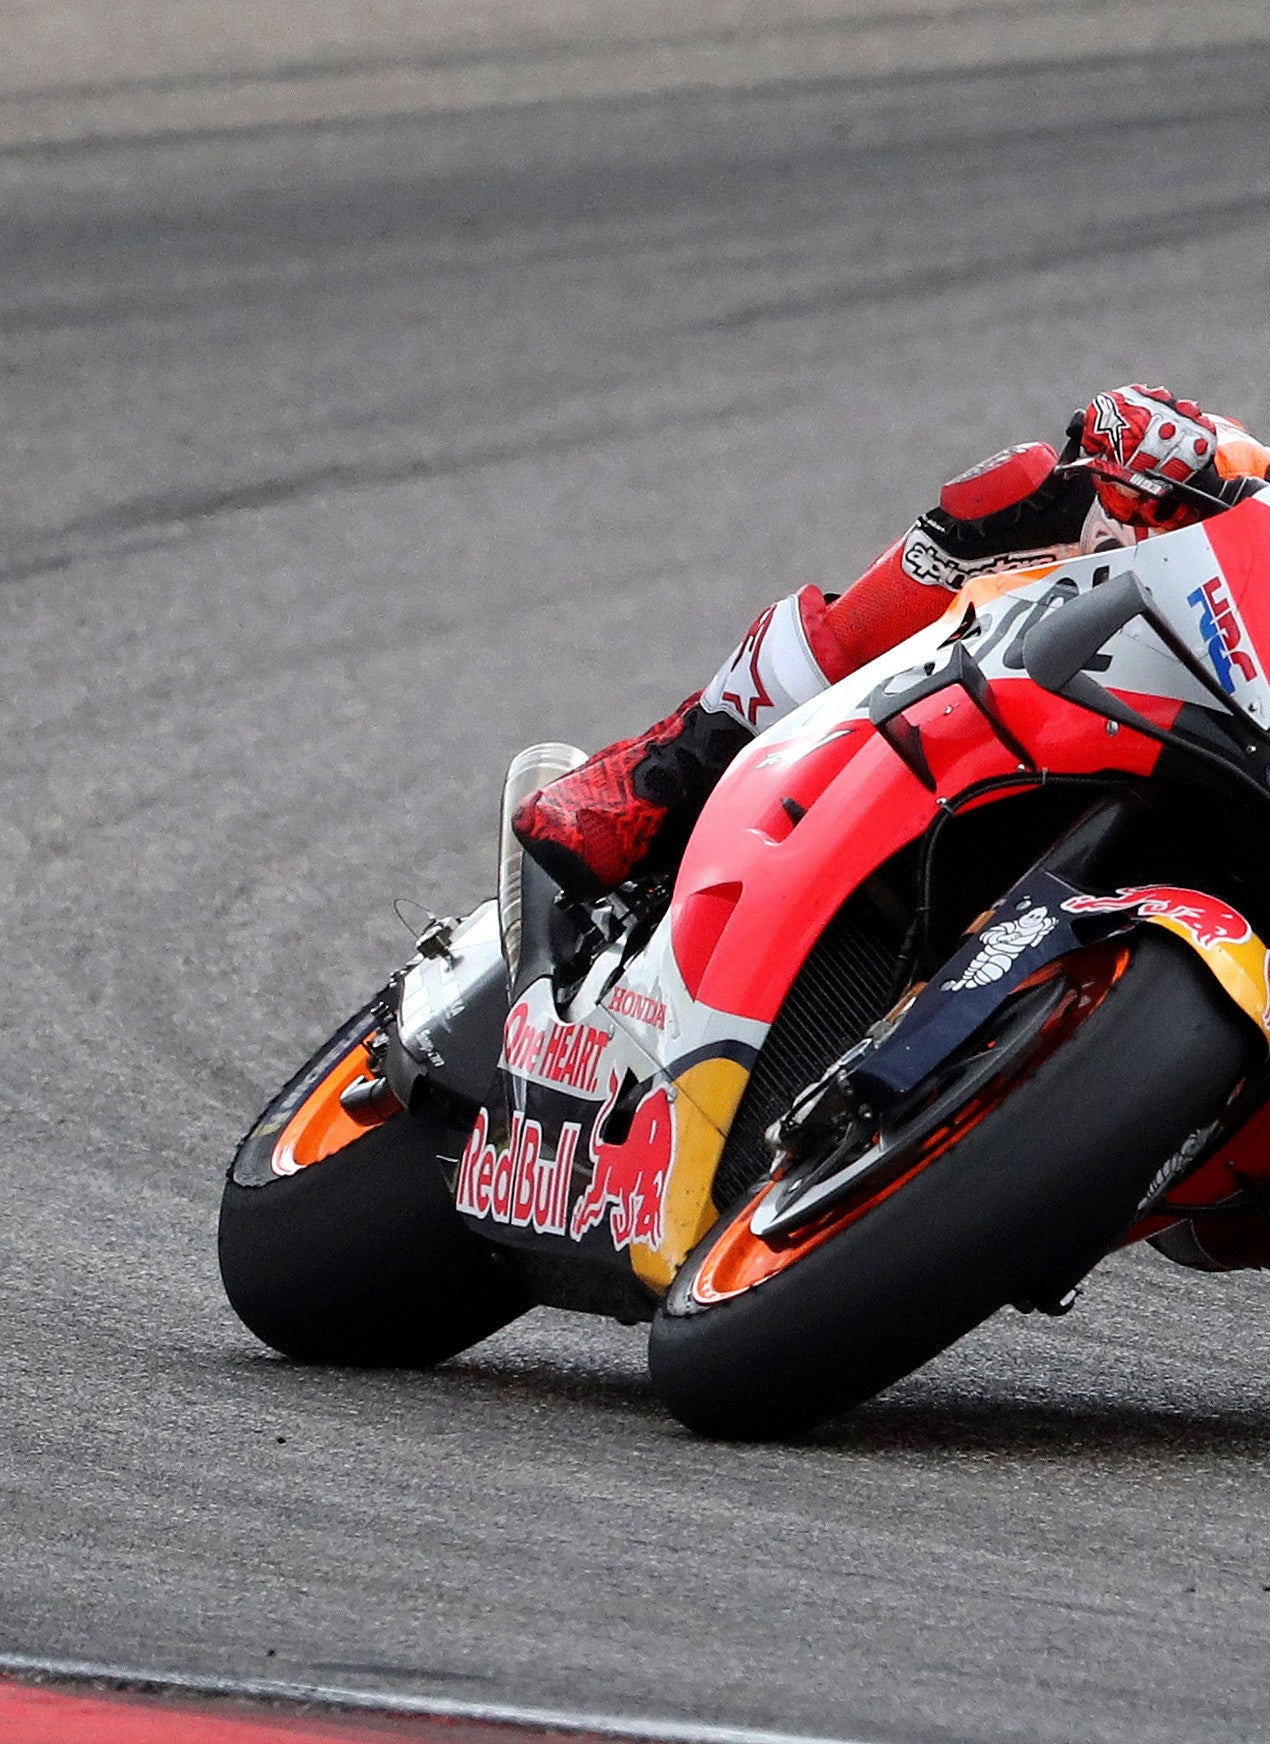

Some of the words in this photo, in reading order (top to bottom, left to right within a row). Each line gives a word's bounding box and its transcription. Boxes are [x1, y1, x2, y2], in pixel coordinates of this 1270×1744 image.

[1187, 576, 1257, 695] HRC
[504, 1003, 545, 1072] One
[608, 986, 667, 1030] HONDA
